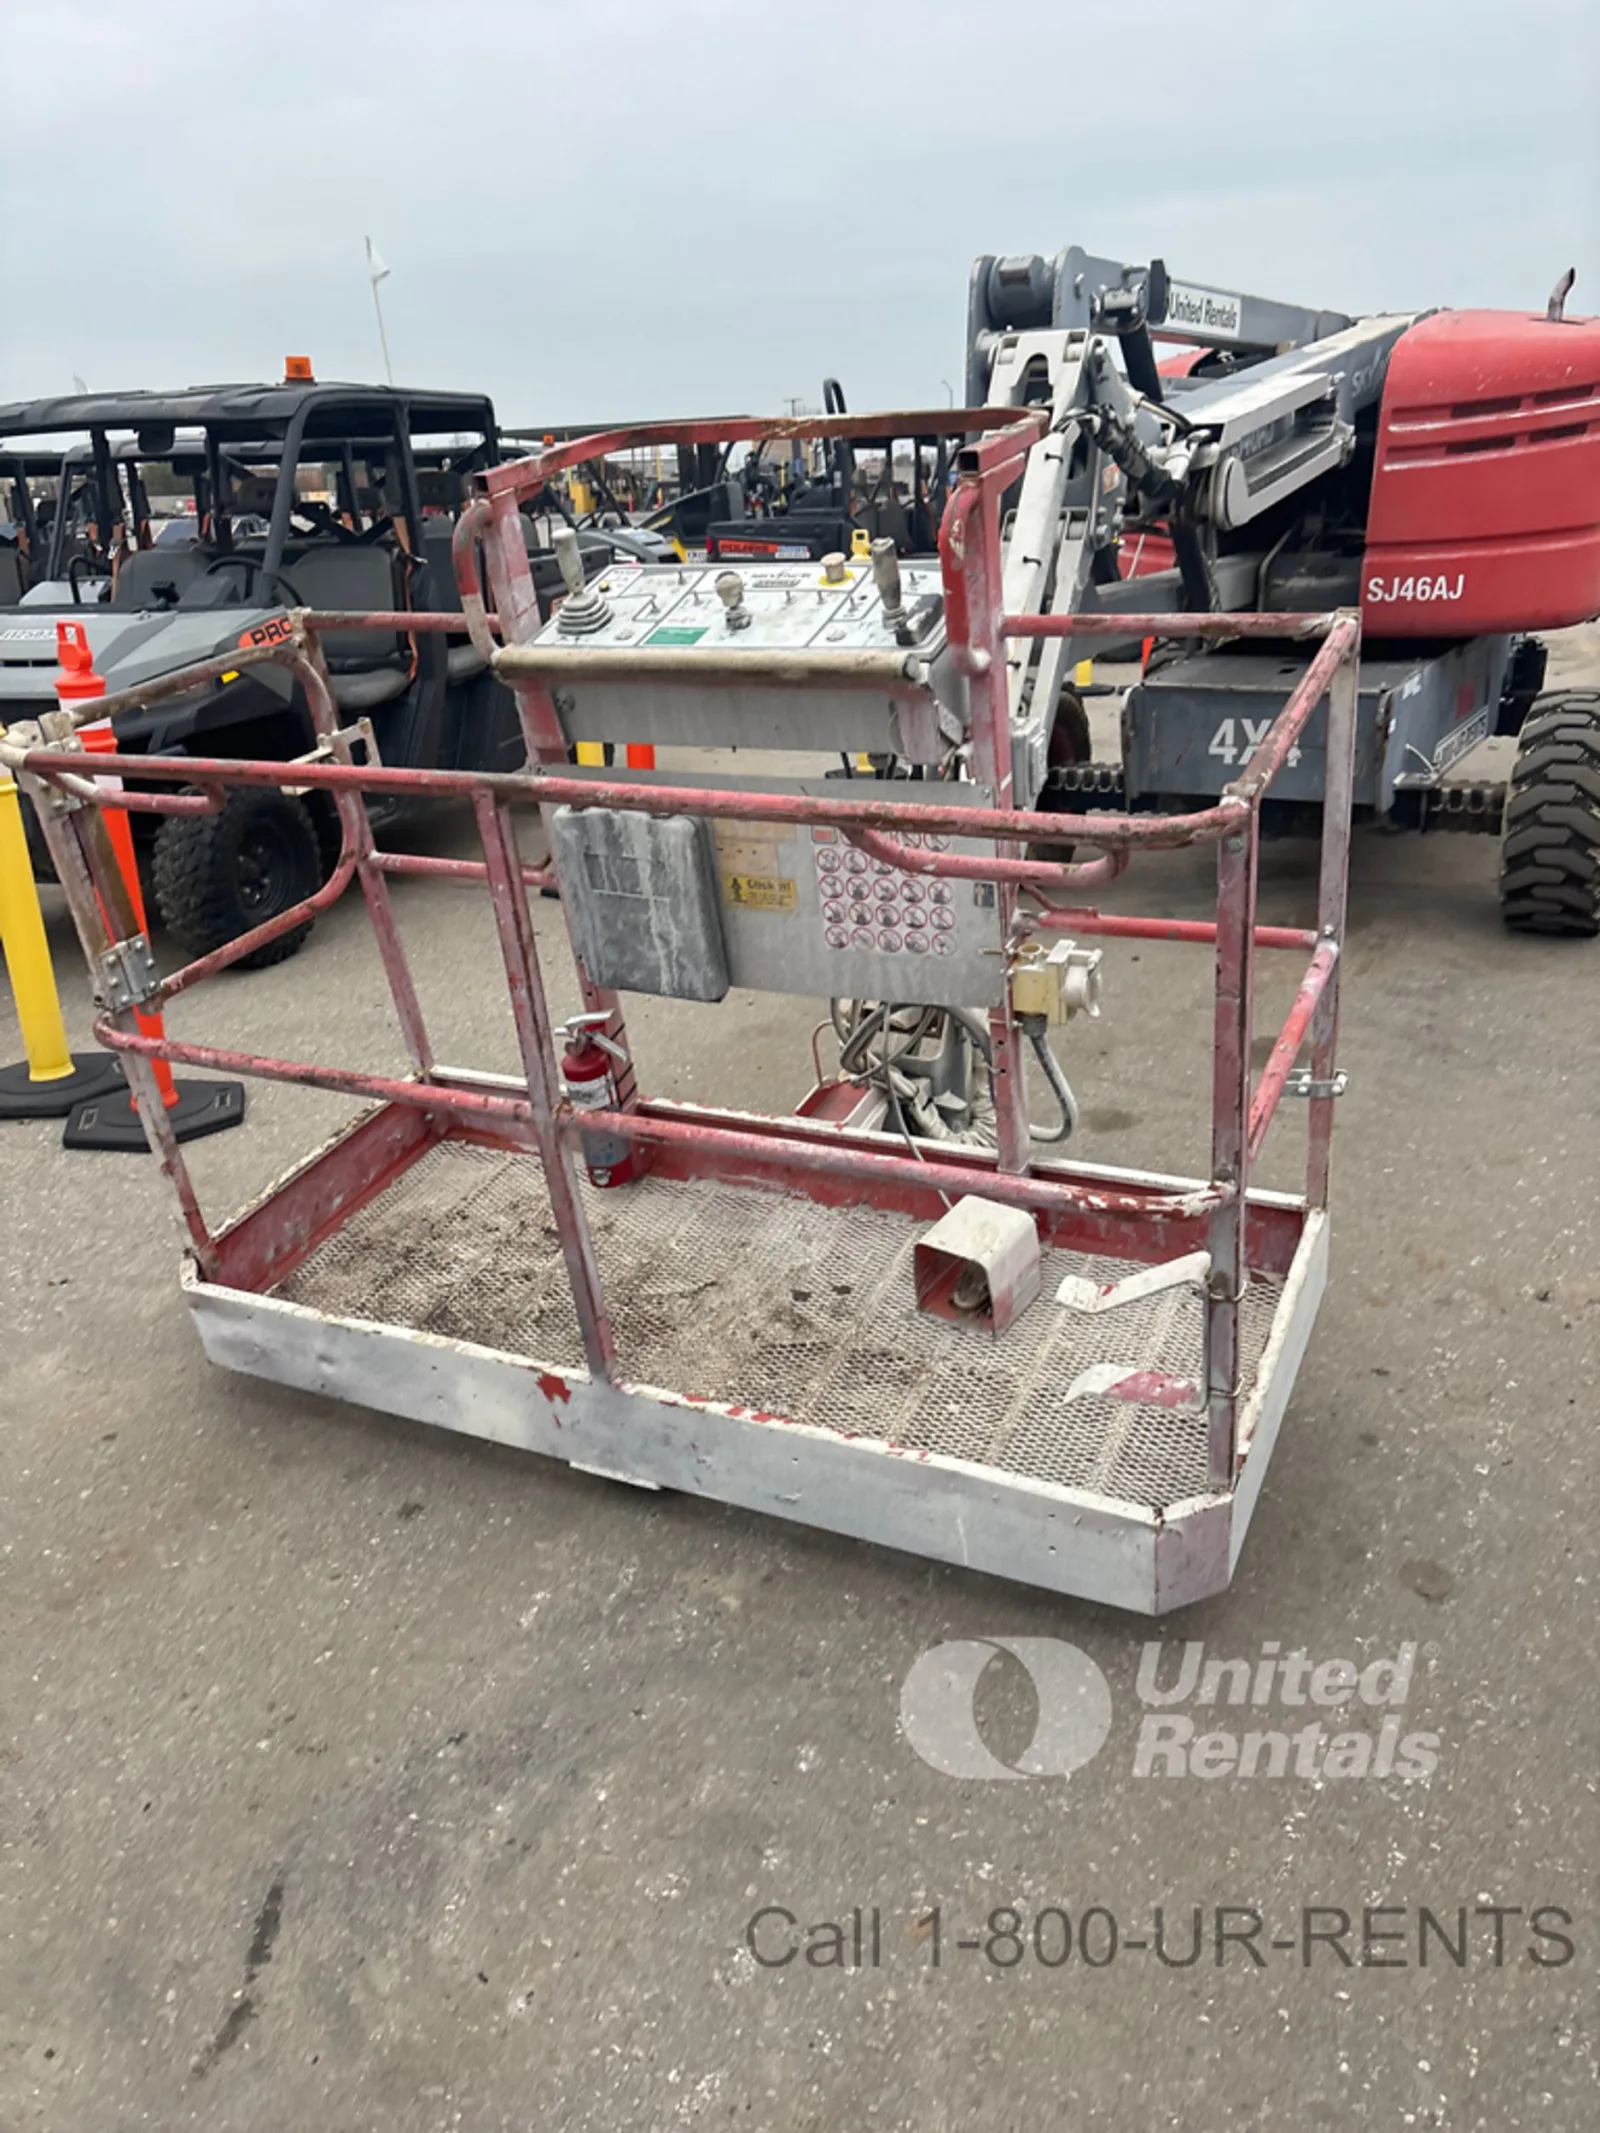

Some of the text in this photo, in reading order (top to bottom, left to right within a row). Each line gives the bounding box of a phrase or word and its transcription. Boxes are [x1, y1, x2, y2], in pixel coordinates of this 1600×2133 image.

[1167, 290, 1238, 331] United Rentals
[1366, 573, 1465, 603] SJ46AJ
